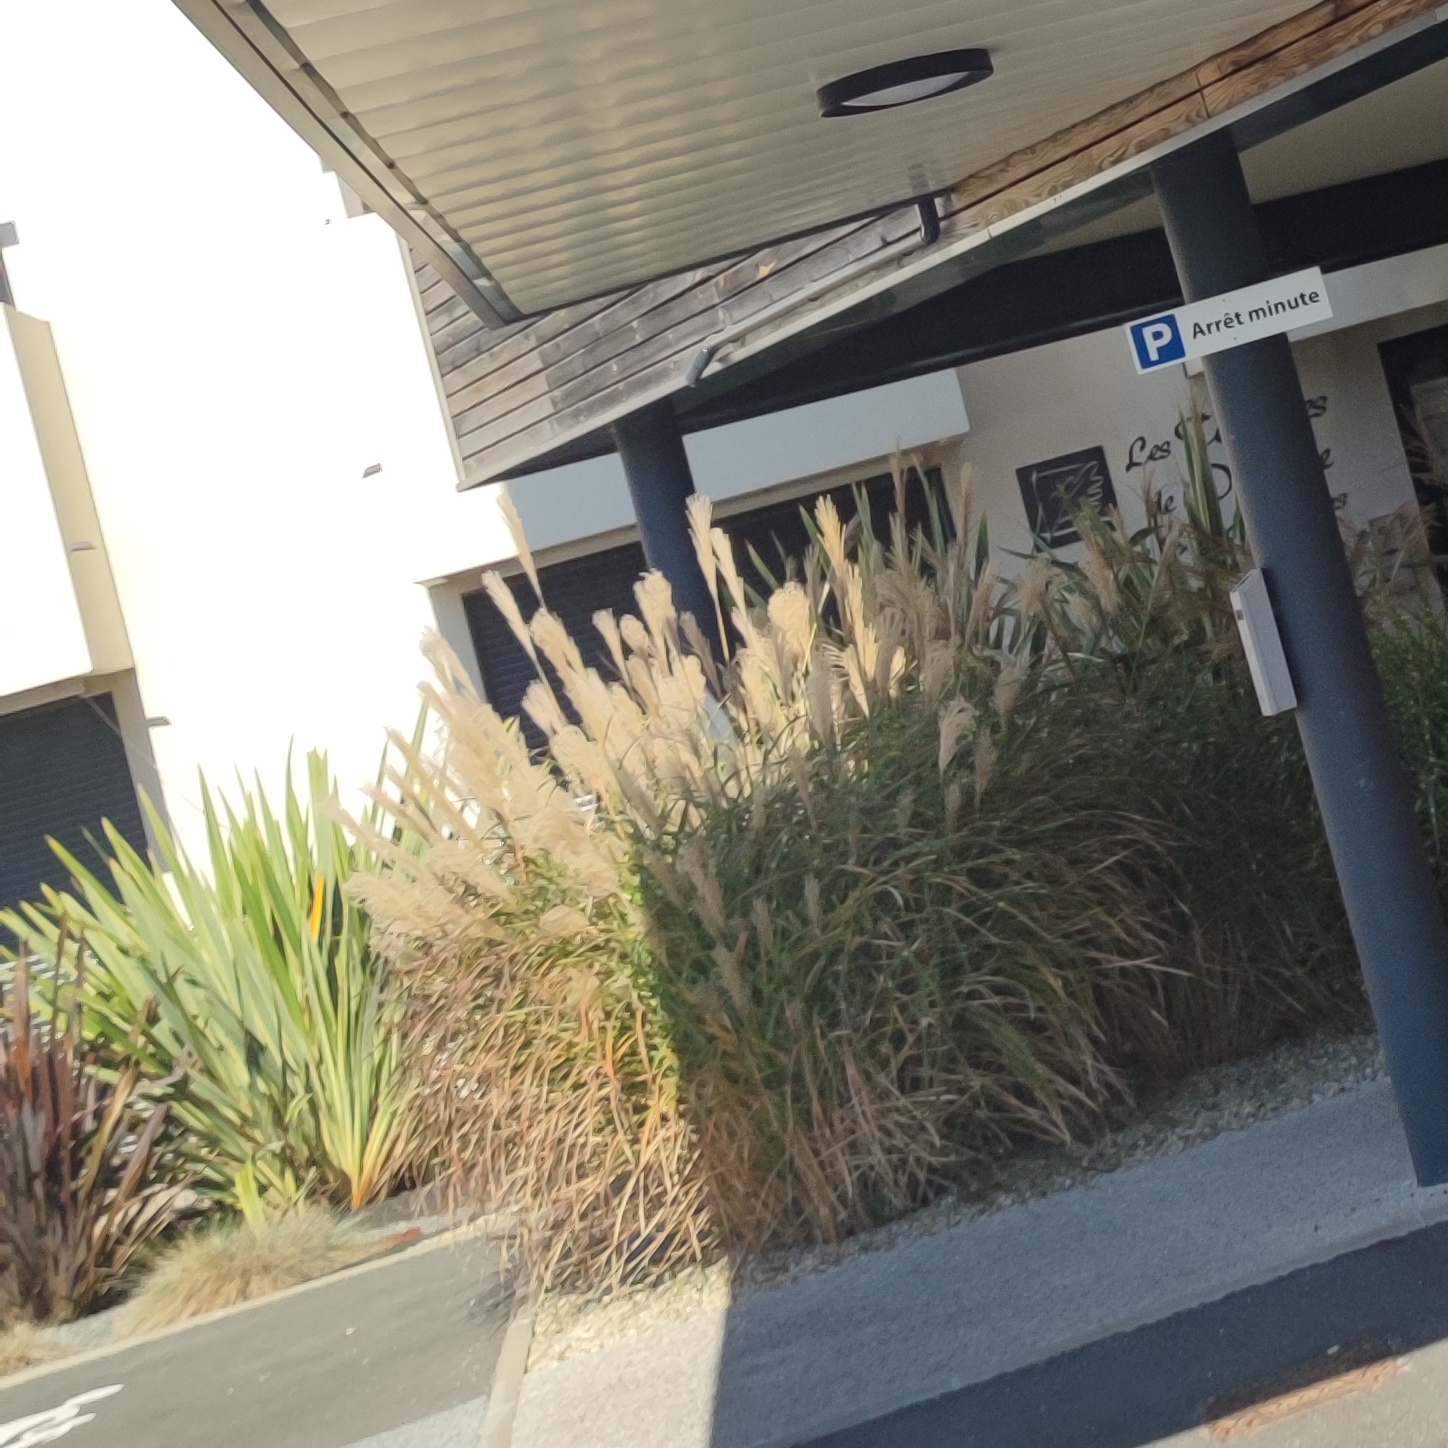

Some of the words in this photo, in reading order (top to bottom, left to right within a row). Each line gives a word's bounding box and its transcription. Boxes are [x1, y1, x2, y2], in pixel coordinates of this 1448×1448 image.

[1192, 311, 1245, 340] Arrêt
[1248, 290, 1322, 323] minute
[1125, 435, 1171, 473] Les
